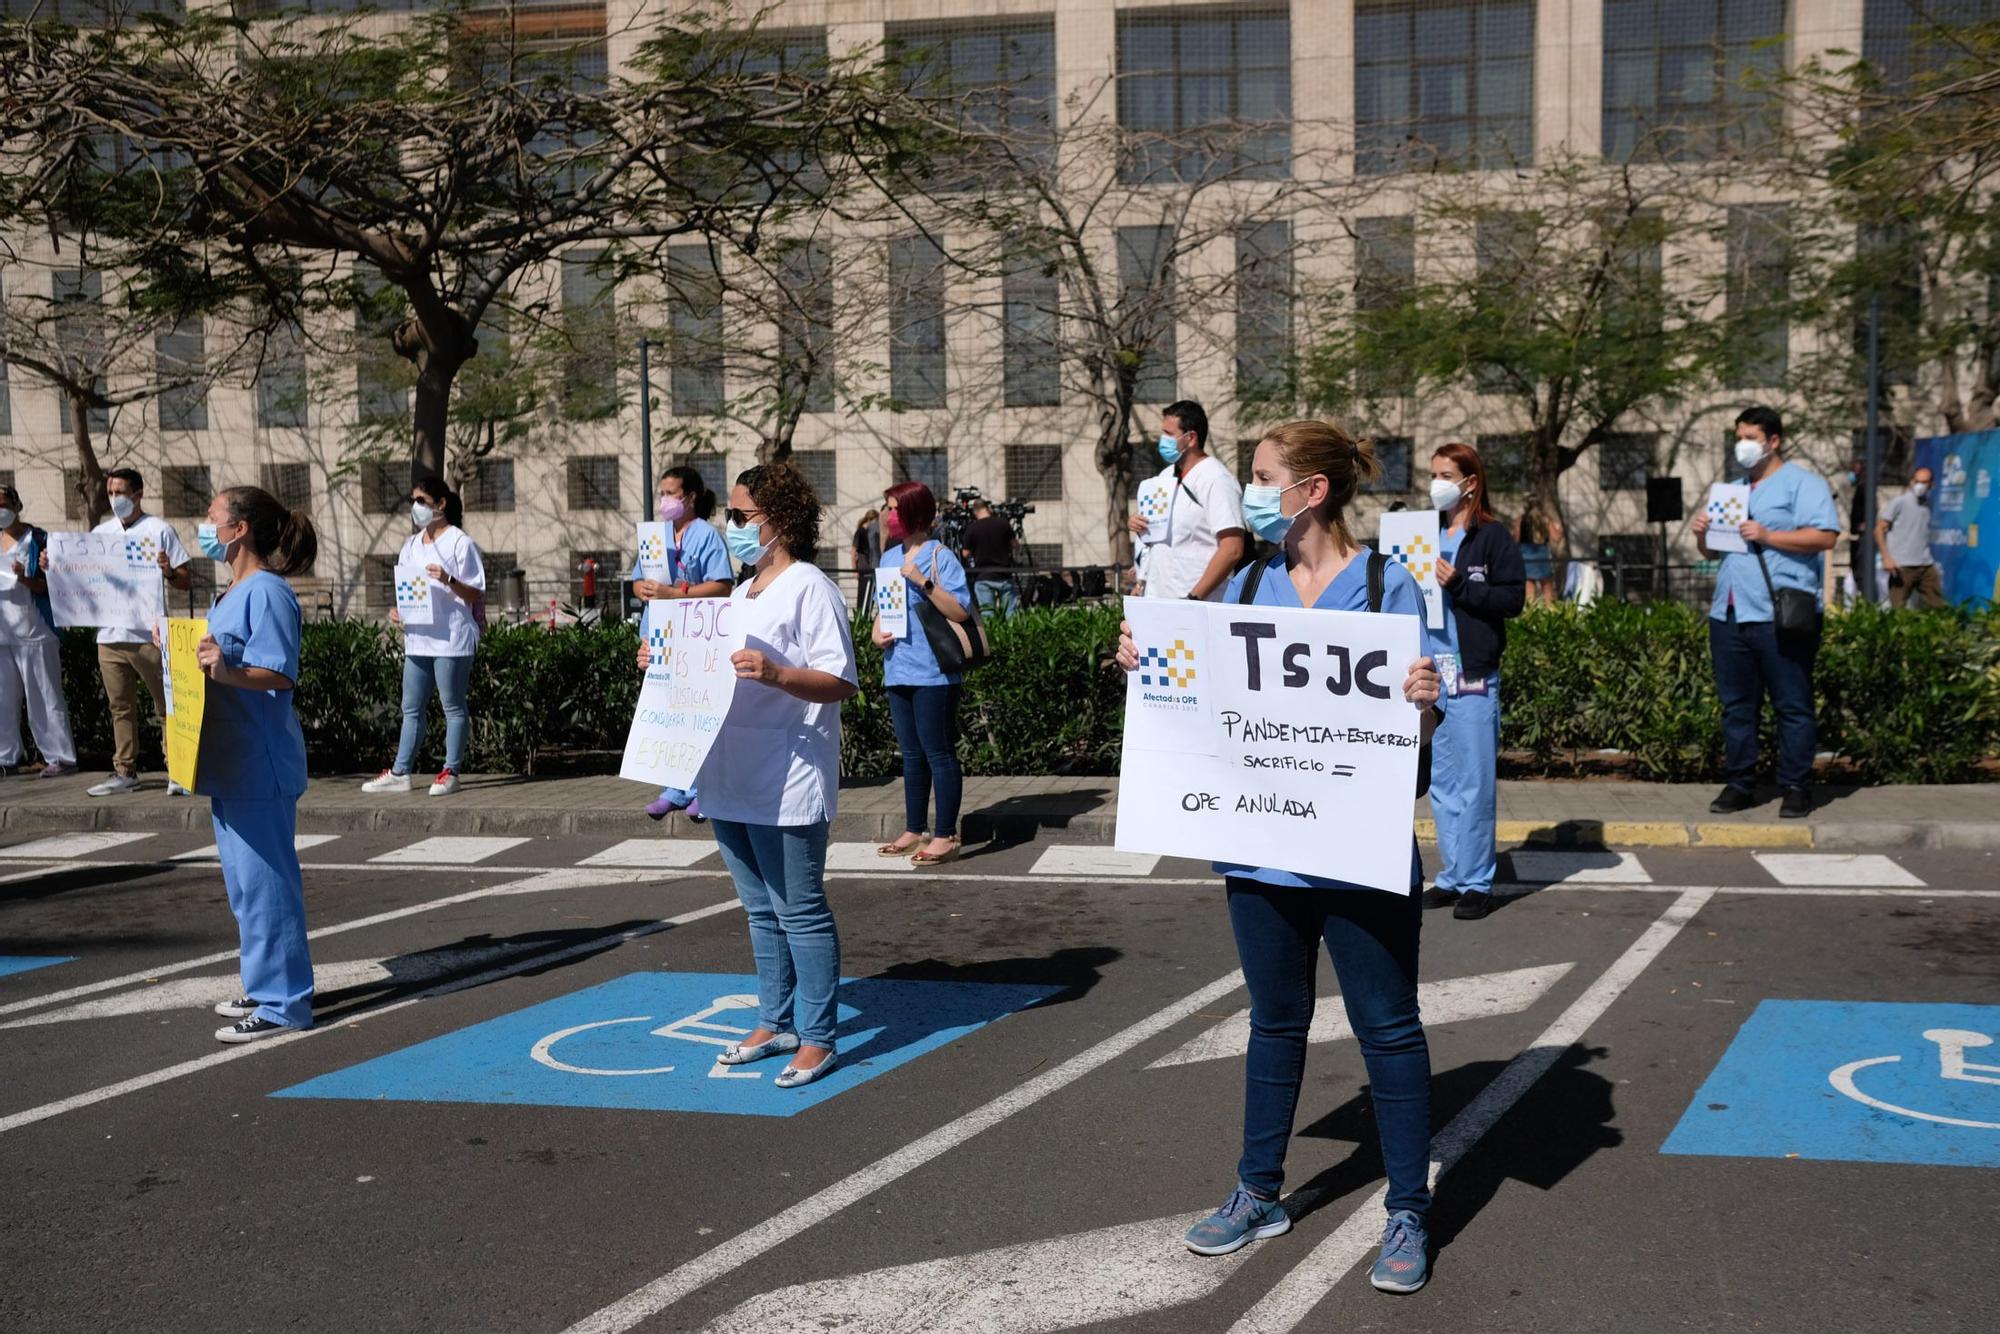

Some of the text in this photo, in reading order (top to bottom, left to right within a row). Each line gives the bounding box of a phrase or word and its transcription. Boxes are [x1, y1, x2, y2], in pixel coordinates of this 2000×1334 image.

[675, 648, 719, 678] ES DE
[1230, 622, 1391, 699] TSJC
[1181, 695, 1198, 705] OPE
[1243, 754, 1325, 772] SACRIFICIO
[1182, 792, 1317, 820] OPE ANULADA
